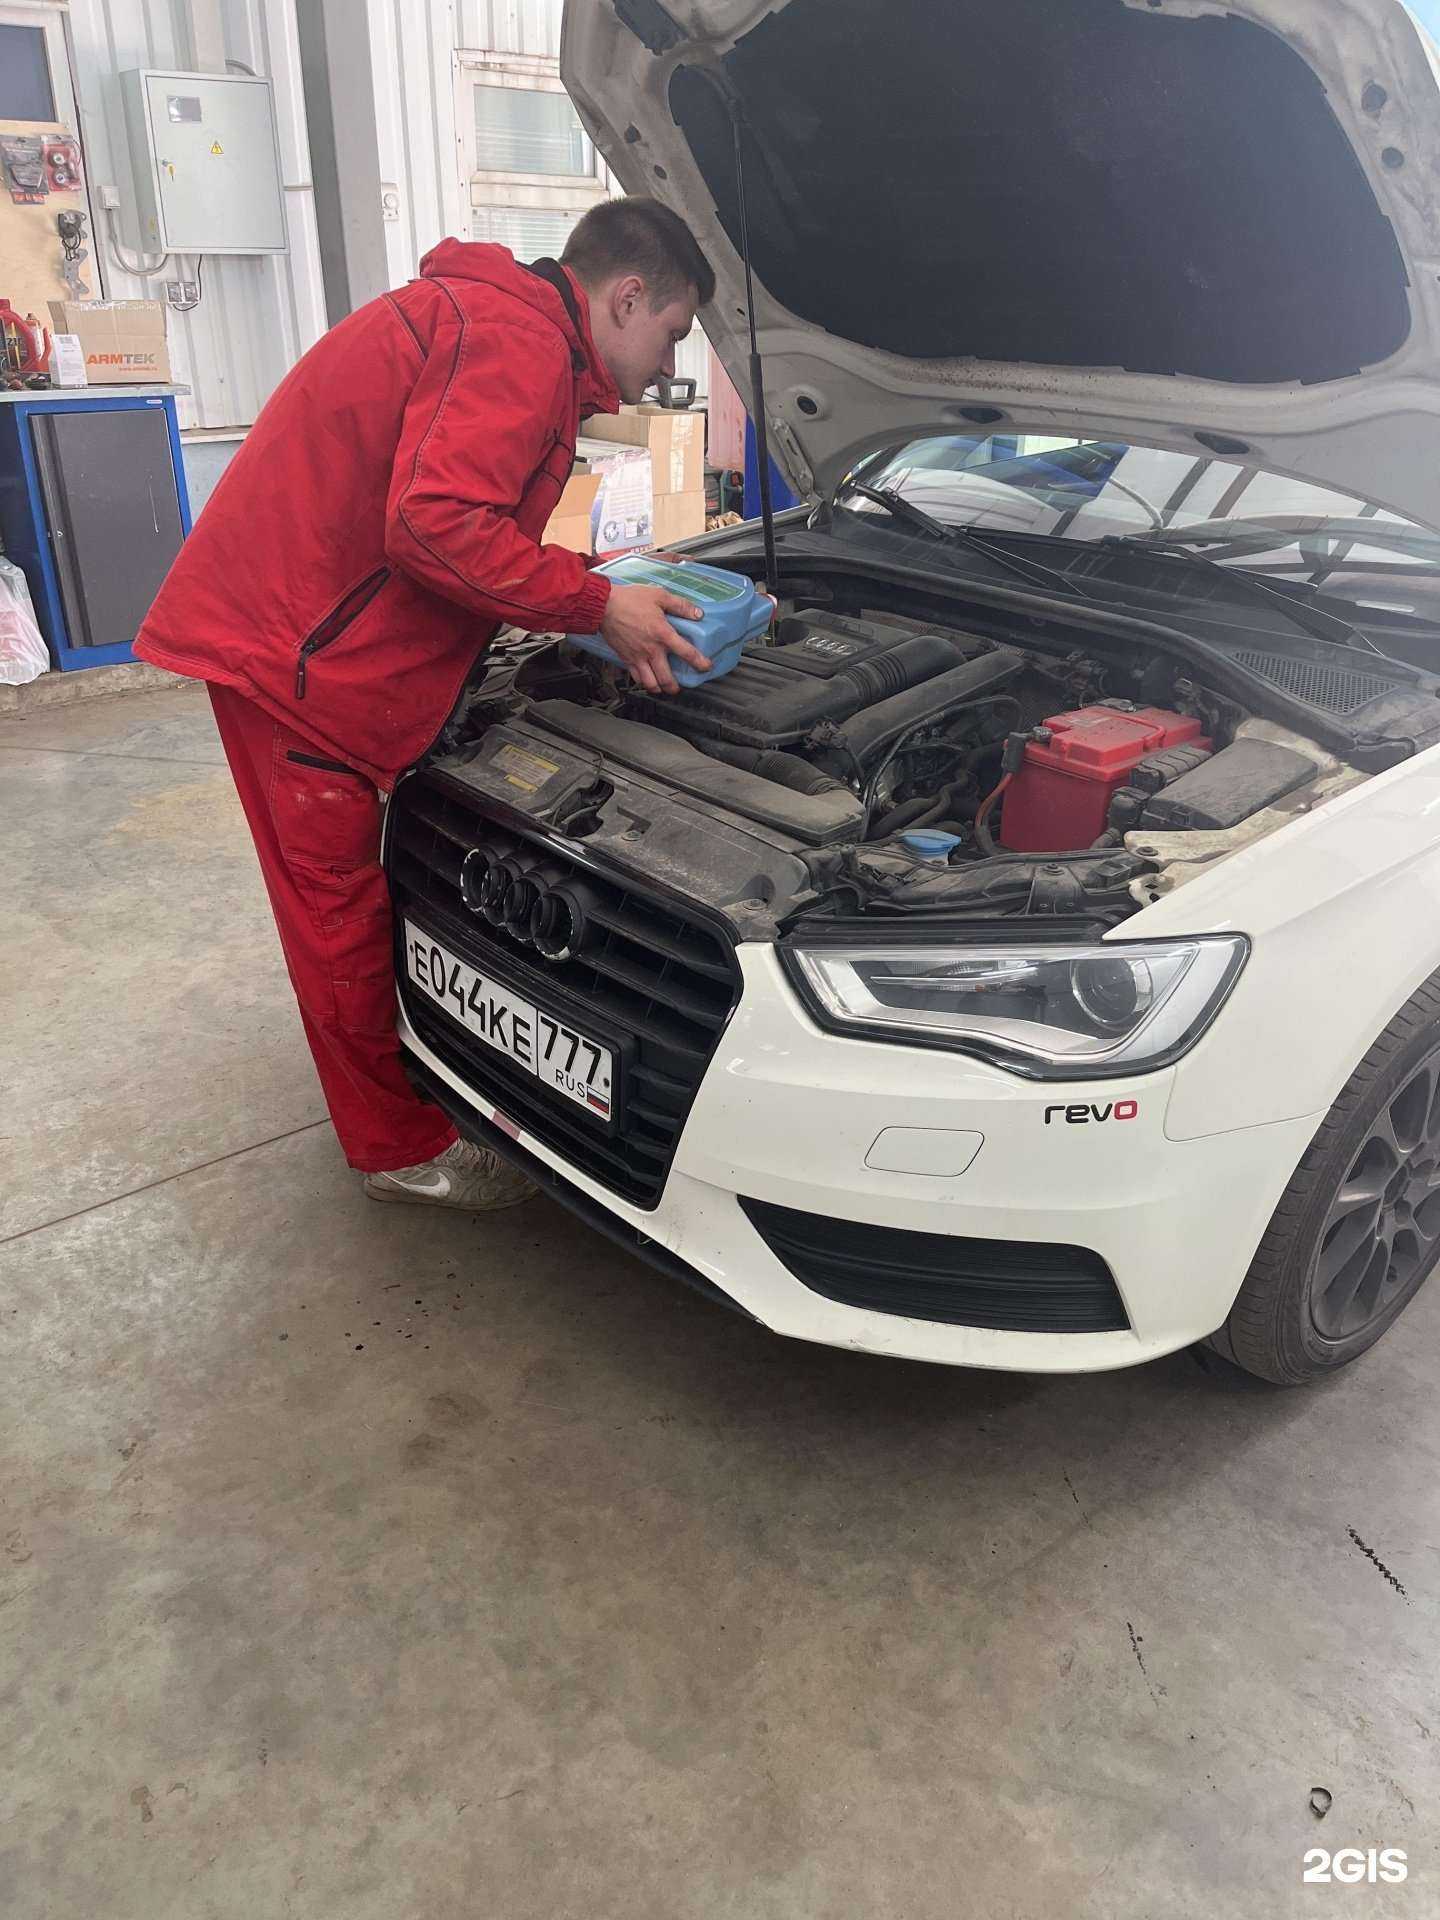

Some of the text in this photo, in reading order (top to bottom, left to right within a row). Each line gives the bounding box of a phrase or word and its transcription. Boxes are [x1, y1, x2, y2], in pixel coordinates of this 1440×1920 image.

[87, 353, 155, 364] ARMTEK
[541, 1015, 602, 1085] 777
[555, 1068, 586, 1098] RUS
[1044, 1100, 1138, 1124] revo
